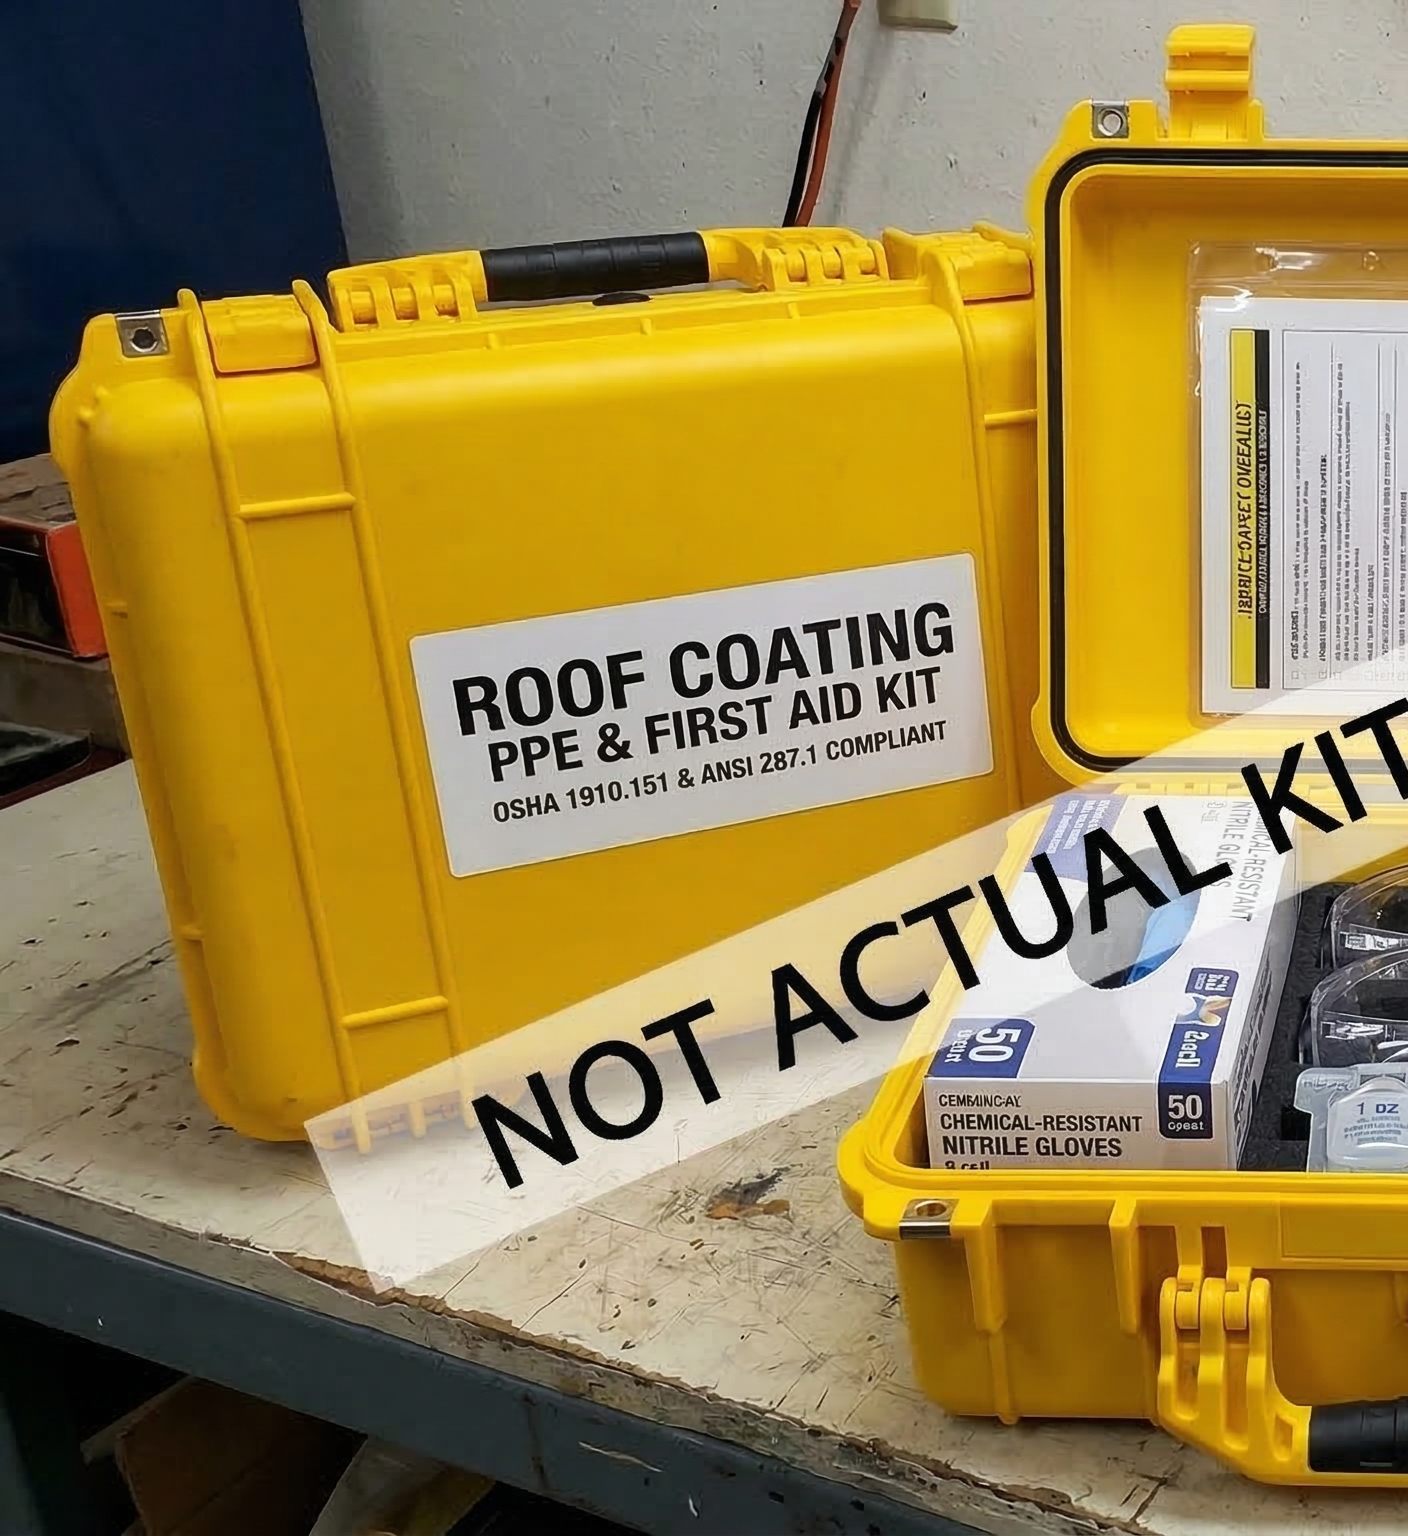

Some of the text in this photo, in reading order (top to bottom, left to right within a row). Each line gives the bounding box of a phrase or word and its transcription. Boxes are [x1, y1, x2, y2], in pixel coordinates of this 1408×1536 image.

[453, 602, 955, 736] ROOF COATING
[488, 666, 942, 783] PPE & FIRST AID KIT
[493, 721, 948, 823] OSHA 1910.151 & ANSI 287.1 COMPLIANT
[1222, 801, 1253, 839] NITRILE
[968, 1027, 1021, 1063] 50
[940, 1113, 1142, 1132] CHEMICAL-RESISTANT
[1168, 1095, 1202, 1121] 50
[1357, 1102, 1365, 1115] 1
[942, 1136, 1123, 1157] NITRILE GLOVES
